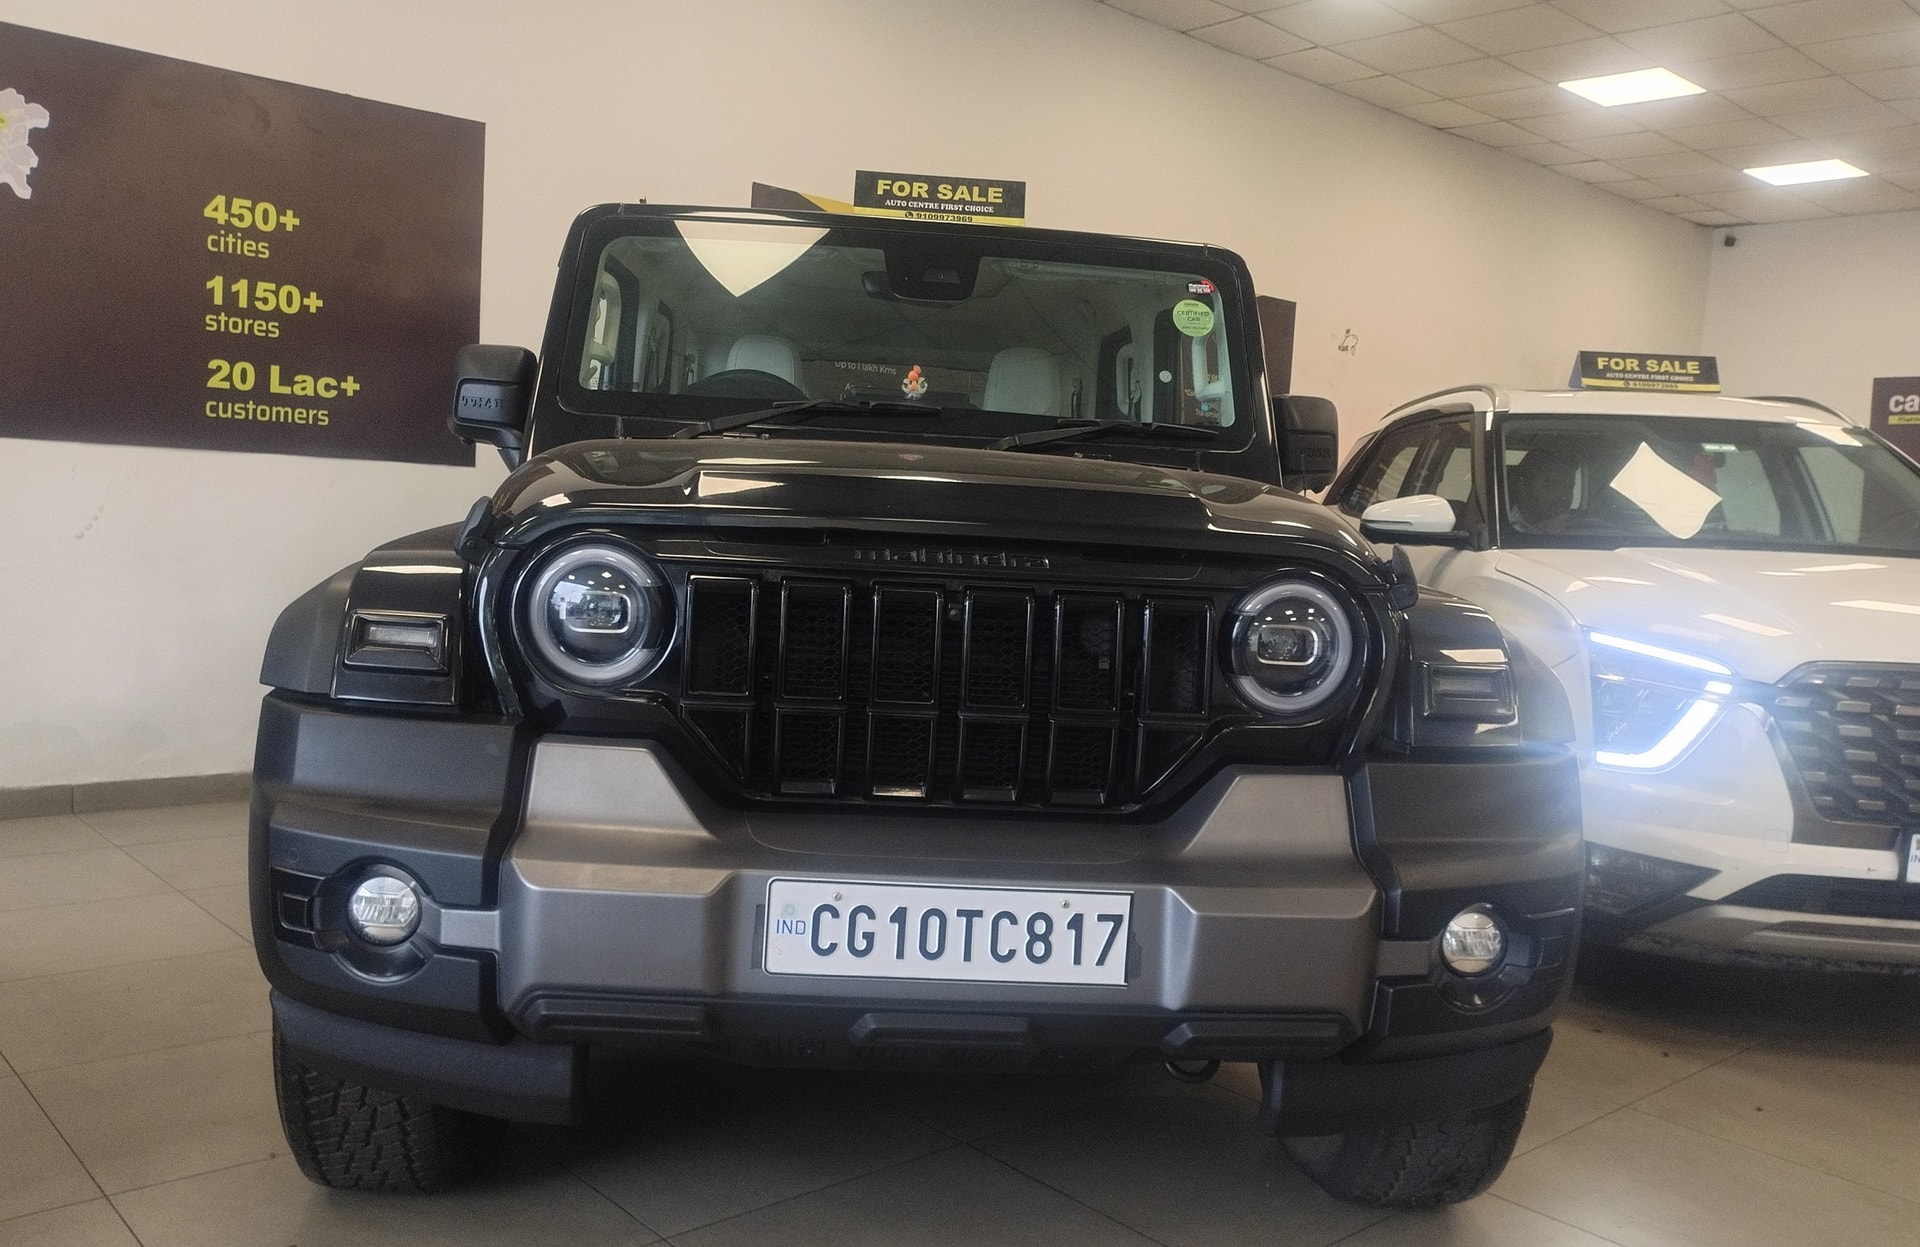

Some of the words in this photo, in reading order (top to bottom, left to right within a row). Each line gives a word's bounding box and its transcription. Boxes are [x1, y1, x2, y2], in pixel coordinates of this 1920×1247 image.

[877, 179, 929, 199] FOR
[937, 184, 1003, 203] SALE
[203, 194, 300, 232] 450+
[885, 199, 907, 208] AUTO
[908, 201, 940, 210] CENTRE
[940, 203, 963, 212] FIRST
[964, 205, 995, 213] CHOICE
[915, 212, 973, 223] 9109973969
[207, 230, 270, 259] cities
[206, 275, 324, 314] 1150+
[205, 312, 280, 338] stores
[848, 362, 856, 370] to
[862, 363, 878, 373] lakh
[880, 365, 897, 375] Kms
[1597, 357, 1640, 371] FOR
[1646, 359, 1701, 374] SALE
[206, 358, 256, 391] 20
[269, 364, 361, 399] Lac+
[205, 400, 329, 425] customers
[854, 547, 1050, 569] mahindra
[775, 918, 807, 936] IND
[810, 903, 1125, 967] CG10TC817
